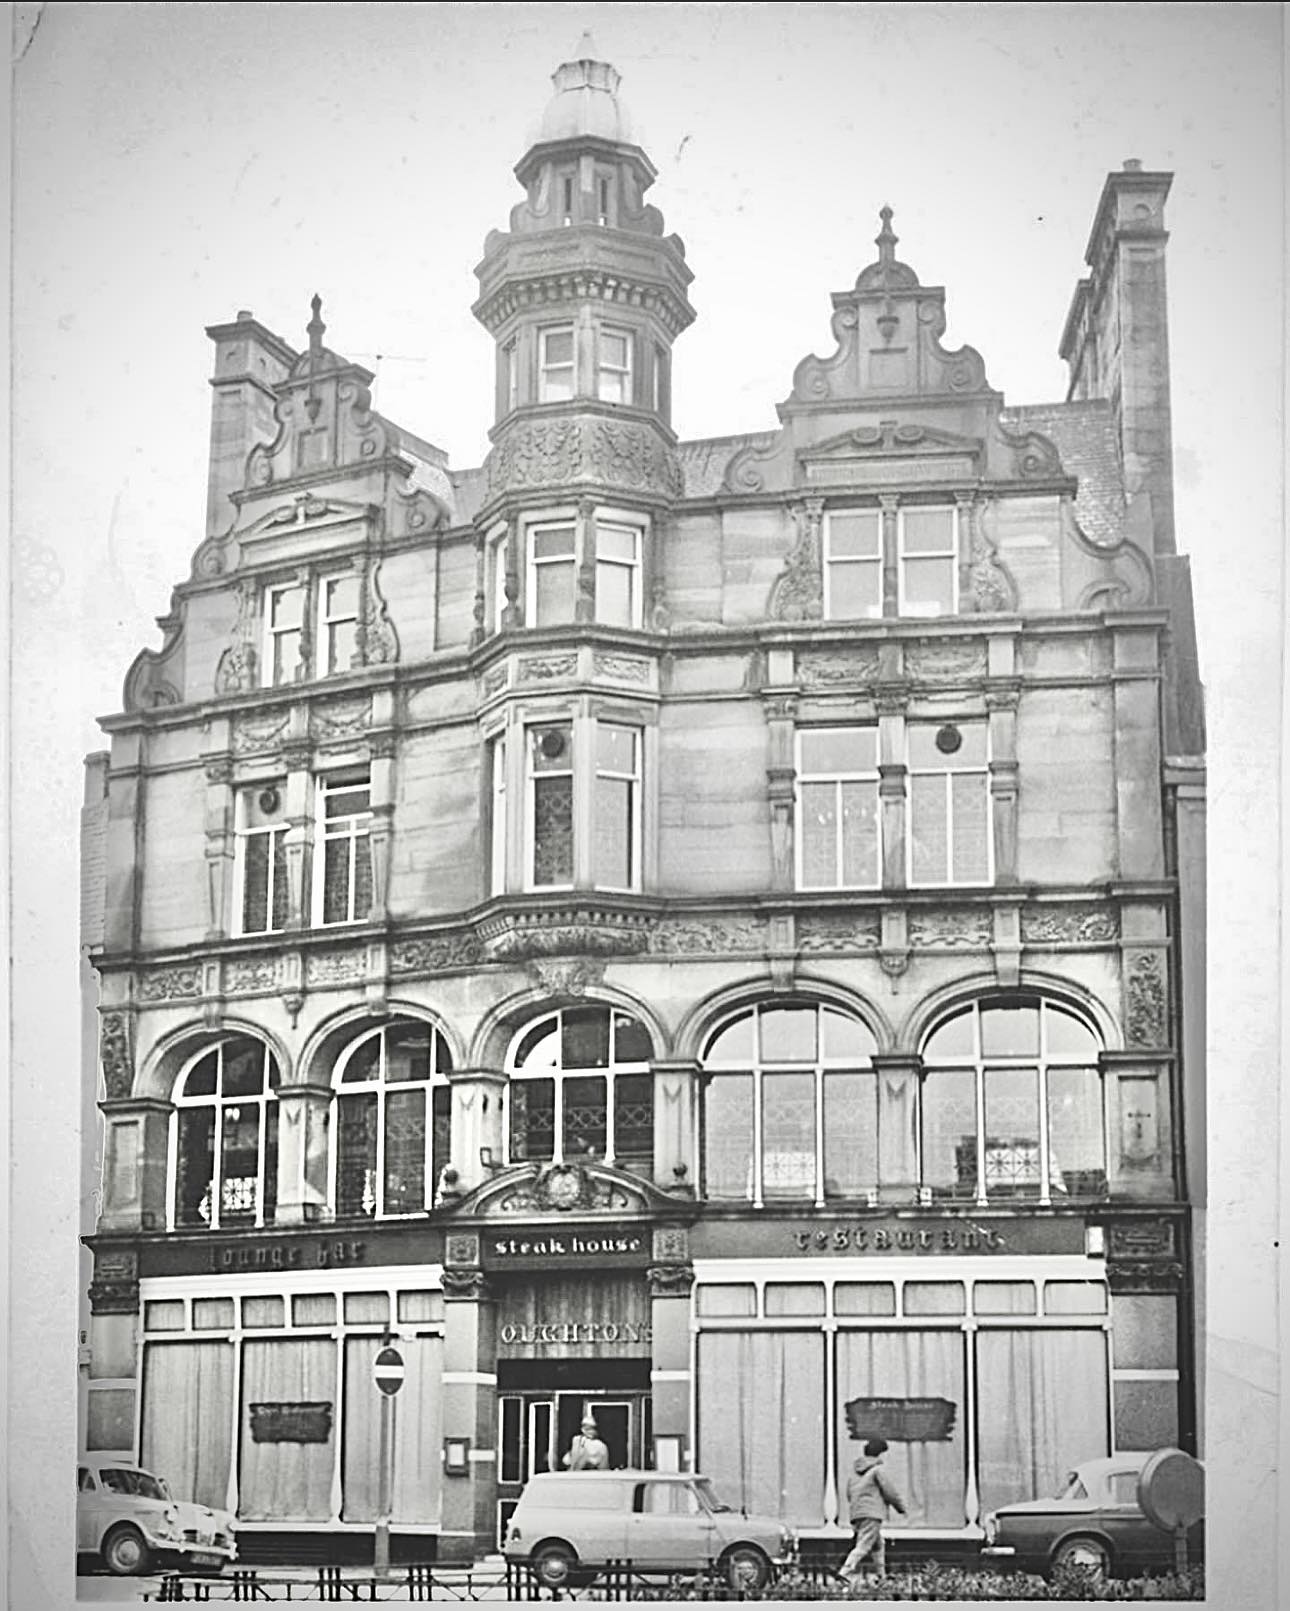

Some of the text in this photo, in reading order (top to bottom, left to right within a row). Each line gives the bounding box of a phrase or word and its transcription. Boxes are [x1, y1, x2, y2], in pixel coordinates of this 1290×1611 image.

[496, 1236, 641, 1255] steak house
[795, 1227, 1001, 1251] restaurant
[316, 1241, 364, 1267] bar
